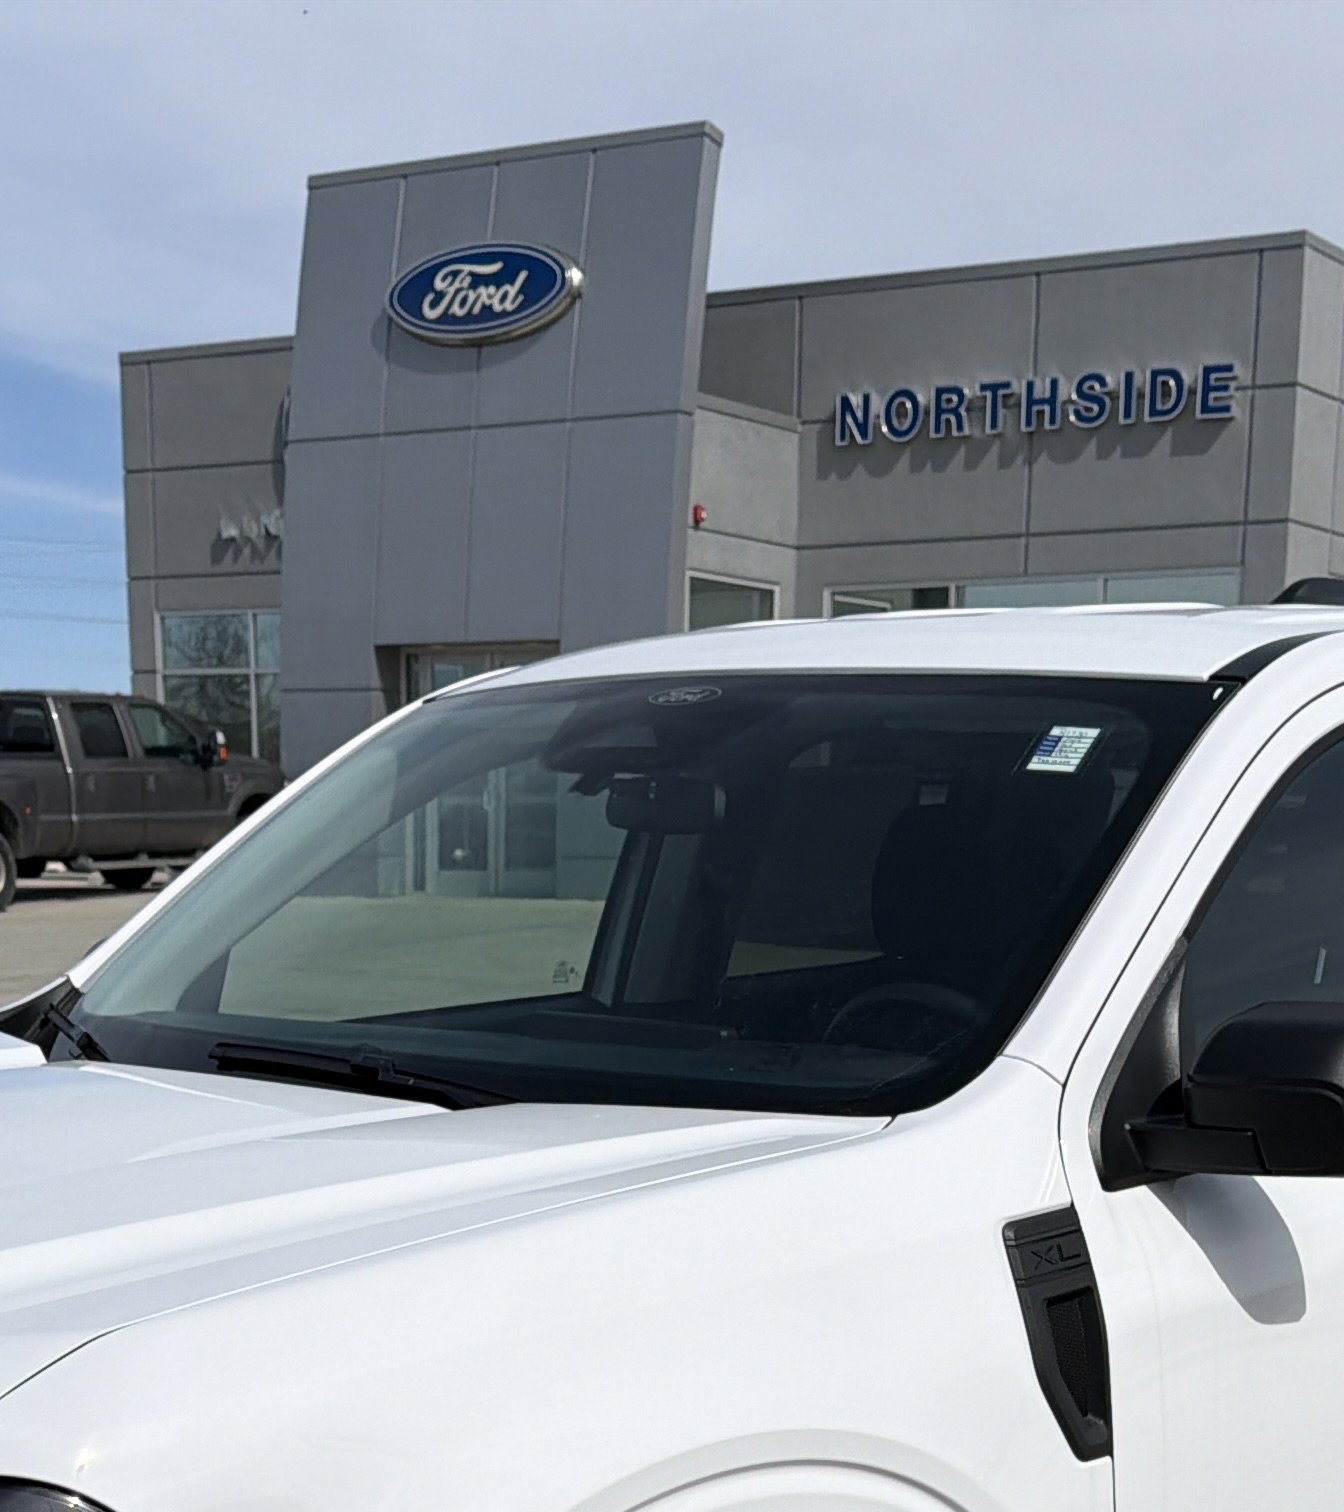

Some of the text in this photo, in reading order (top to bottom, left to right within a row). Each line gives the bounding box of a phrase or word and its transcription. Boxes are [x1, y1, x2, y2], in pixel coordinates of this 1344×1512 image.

[422, 261, 529, 321] Ford
[834, 362, 1238, 448] NORTHSIDE
[1030, 1243, 1082, 1270] XL
